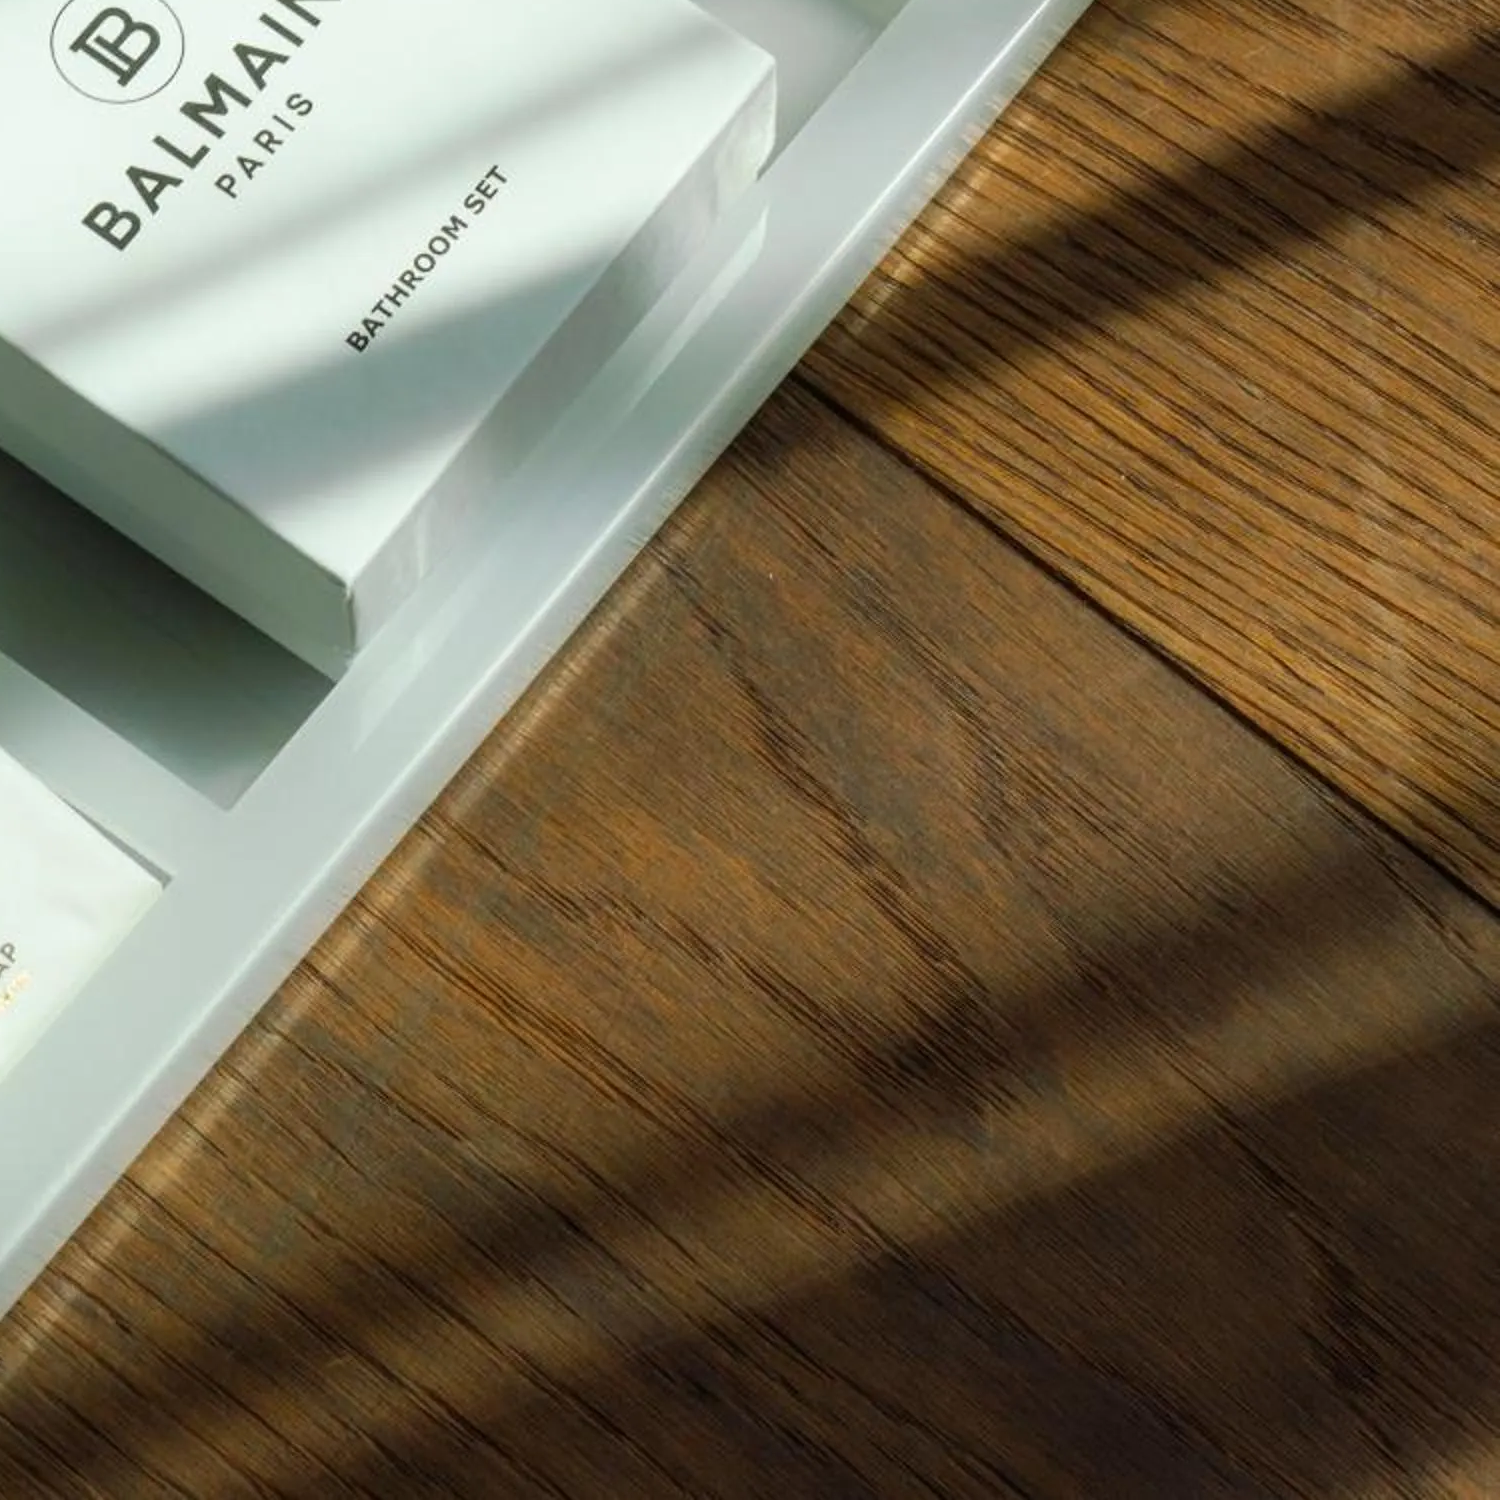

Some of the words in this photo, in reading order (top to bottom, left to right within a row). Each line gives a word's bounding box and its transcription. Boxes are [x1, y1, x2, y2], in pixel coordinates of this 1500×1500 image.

[213, 92, 314, 200] PARIS
[344, 214, 469, 354] BATHROOM
[463, 164, 508, 216] SET
